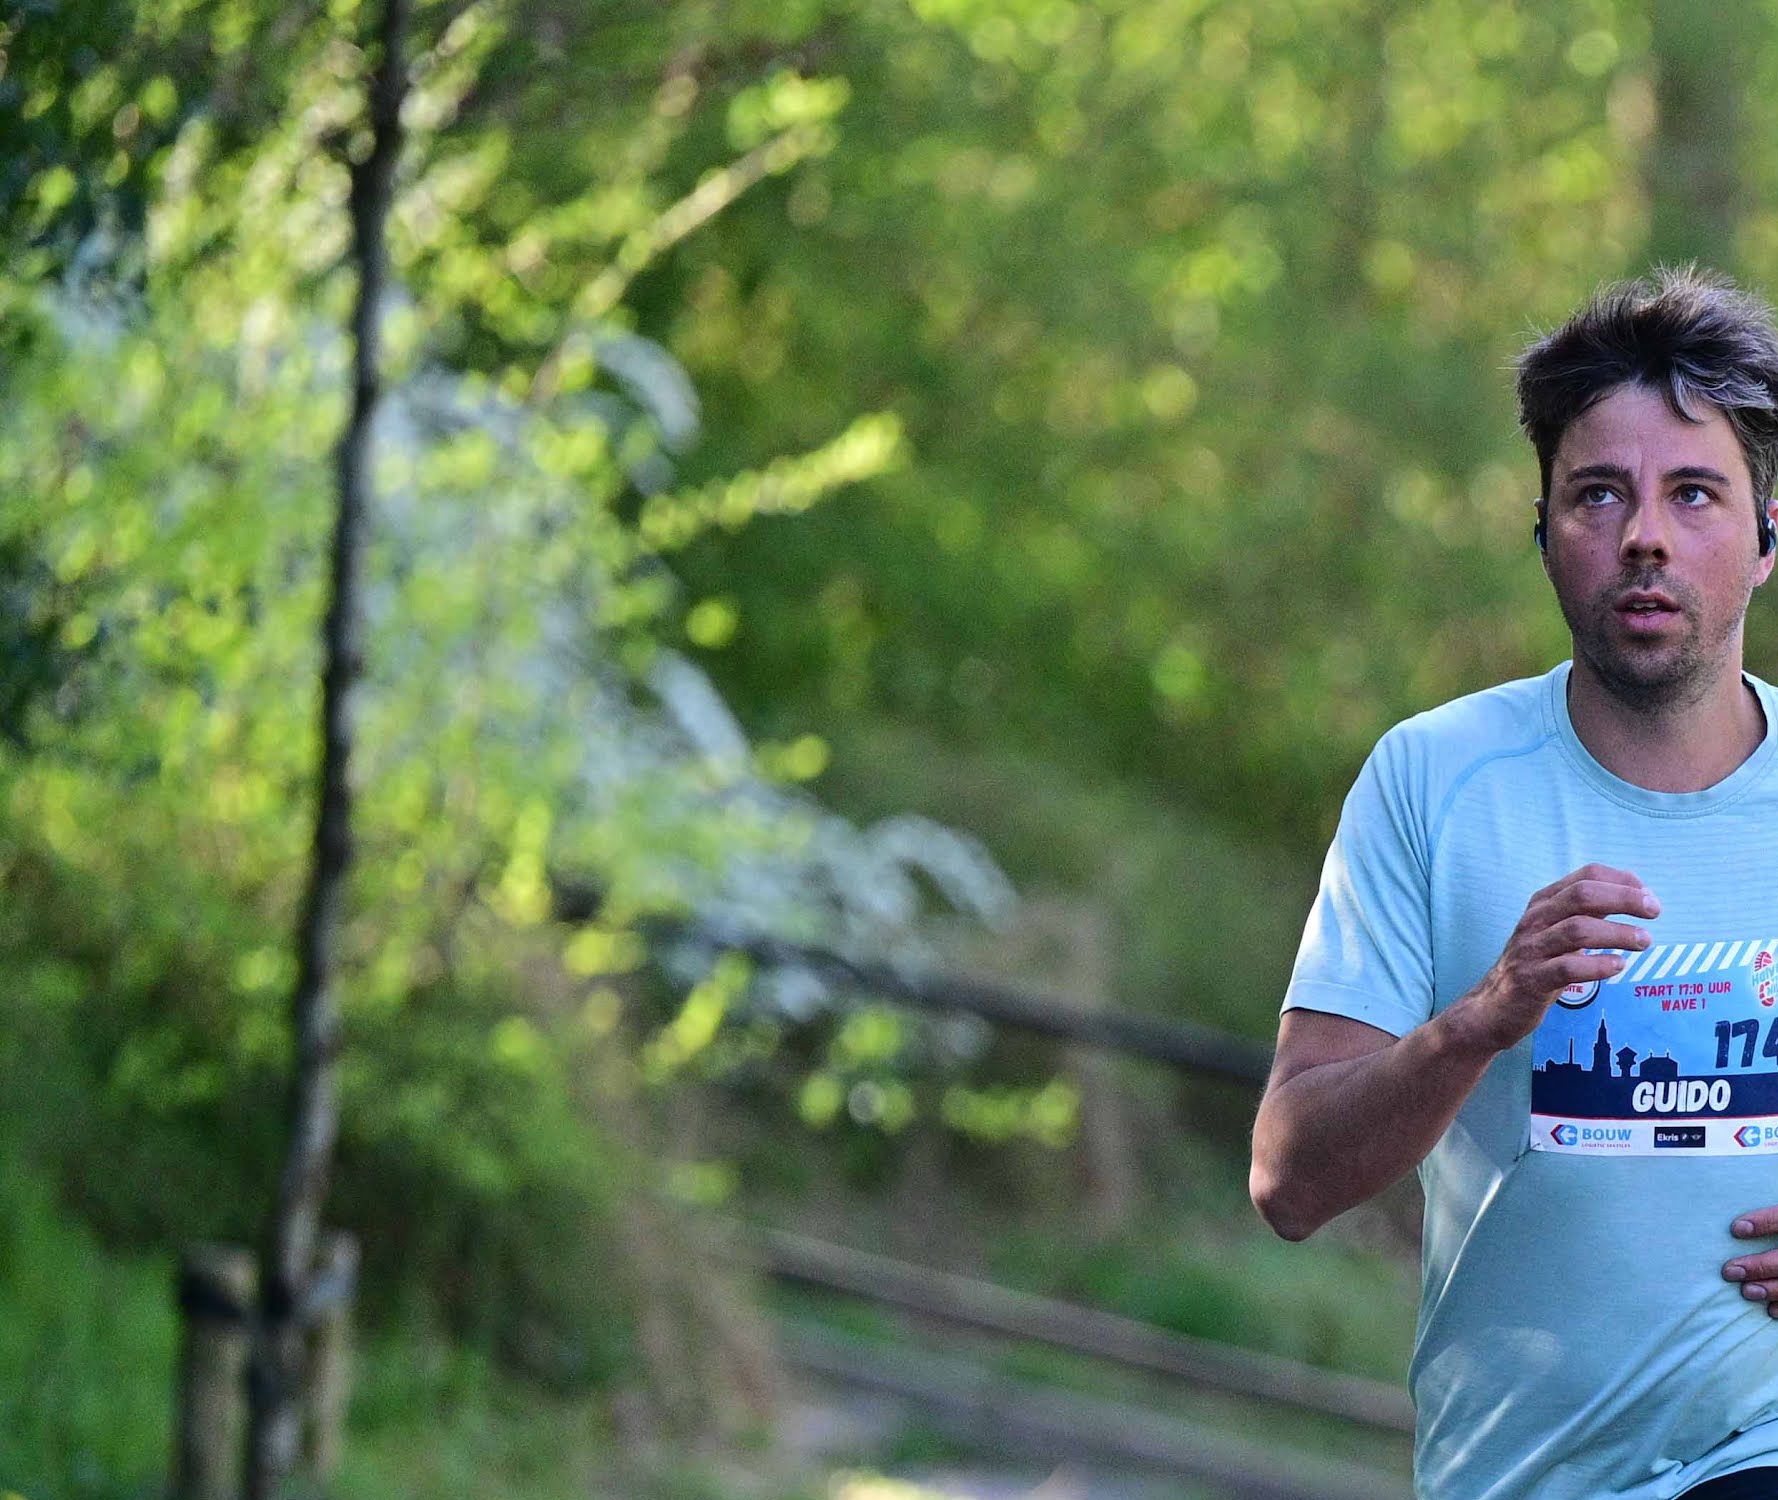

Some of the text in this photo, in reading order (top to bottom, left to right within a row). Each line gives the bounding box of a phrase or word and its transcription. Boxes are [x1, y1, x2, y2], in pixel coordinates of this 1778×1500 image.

[1634, 981, 1732, 998] START 17:10 UUR
[1661, 998, 1706, 1012] WAVE 1
[1631, 1078, 1732, 1113] GUIDO
[1582, 1128, 1632, 1141] BOUW
[1656, 1133, 1679, 1142] Ekris
